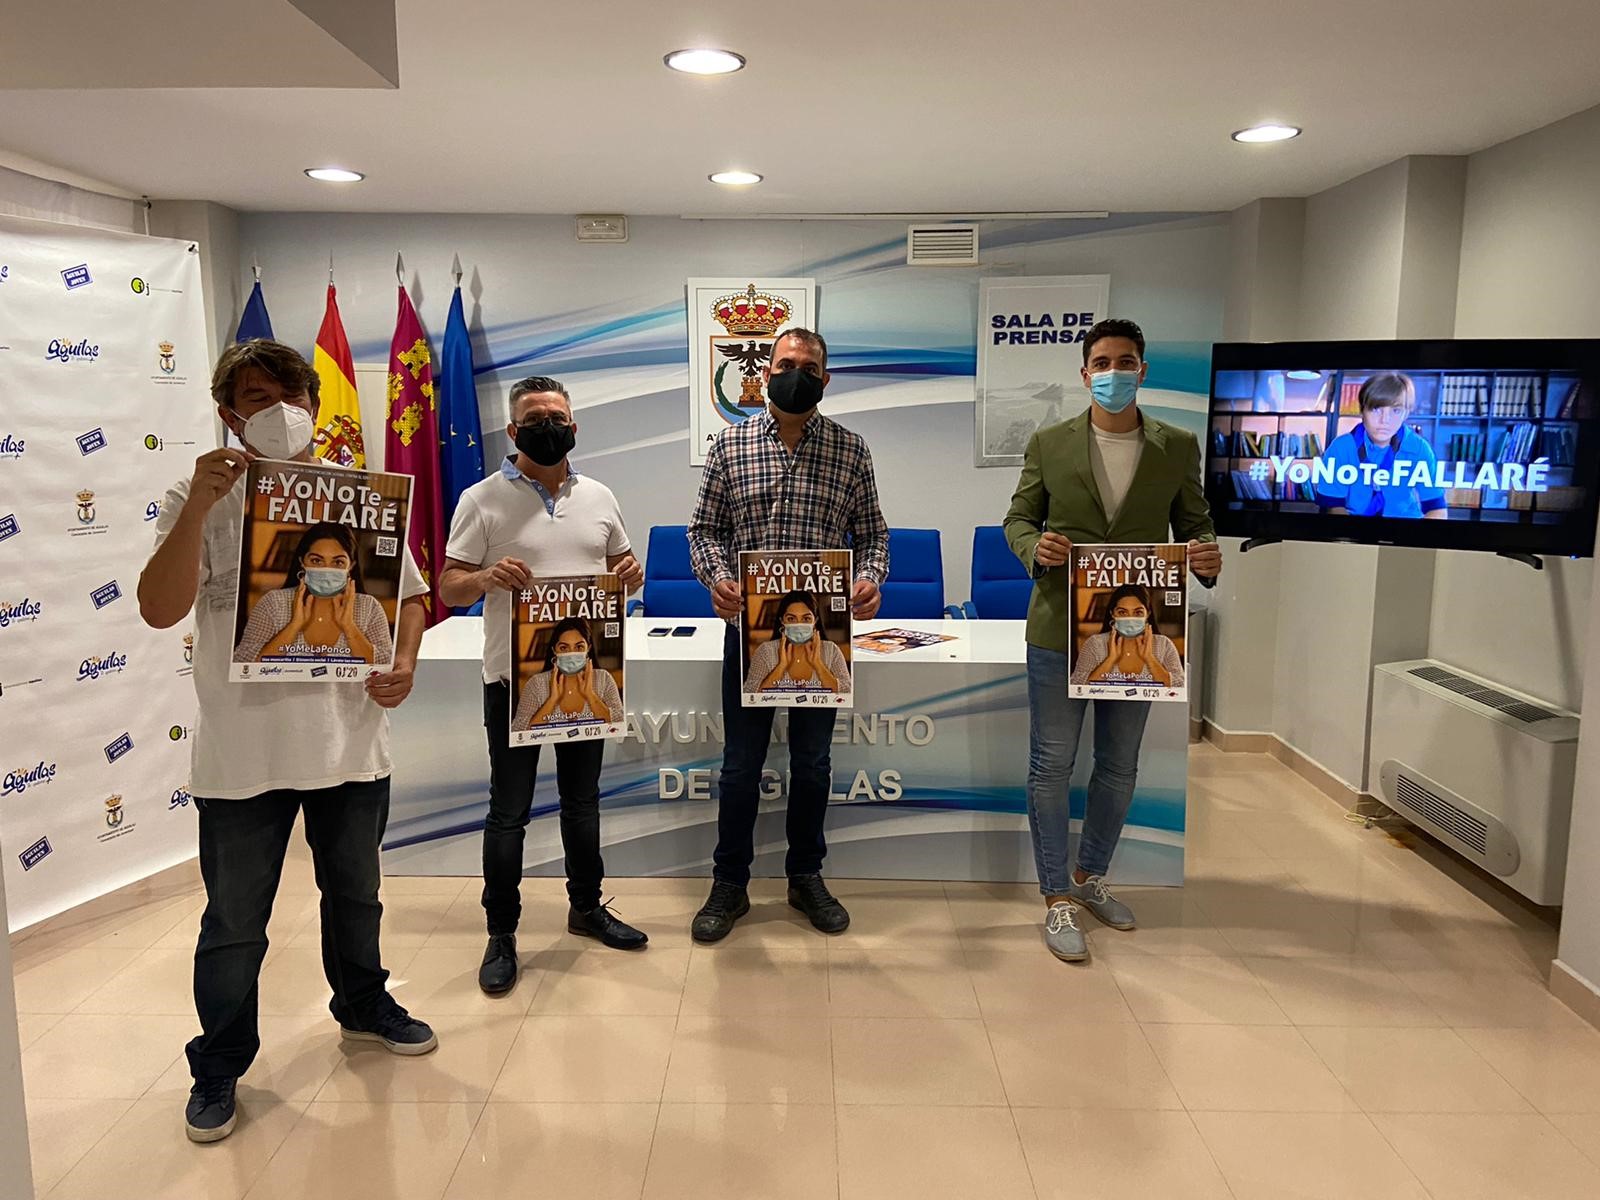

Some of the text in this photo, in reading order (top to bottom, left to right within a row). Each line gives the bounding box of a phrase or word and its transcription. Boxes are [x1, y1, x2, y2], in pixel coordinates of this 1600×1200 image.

[991, 312, 1095, 329] SALA DE
[993, 329, 1085, 346] PRENSA
[1249, 455, 1550, 492] #YoNoTeFALLARÉ
[257, 472, 382, 507] #YoNoTe
[268, 502, 398, 532] FALLARÉ
[747, 558, 831, 576] #YoNoTe
[1078, 552, 1166, 570] #YoNoTe
[756, 571, 844, 594] FALLARÉ
[1086, 566, 1179, 588] FALLARÉ
[520, 583, 606, 603] #YoNoTe
[0, 598, 41, 627] guilas
[528, 595, 617, 622] FALLARÉ
[659, 768, 711, 800] DE
